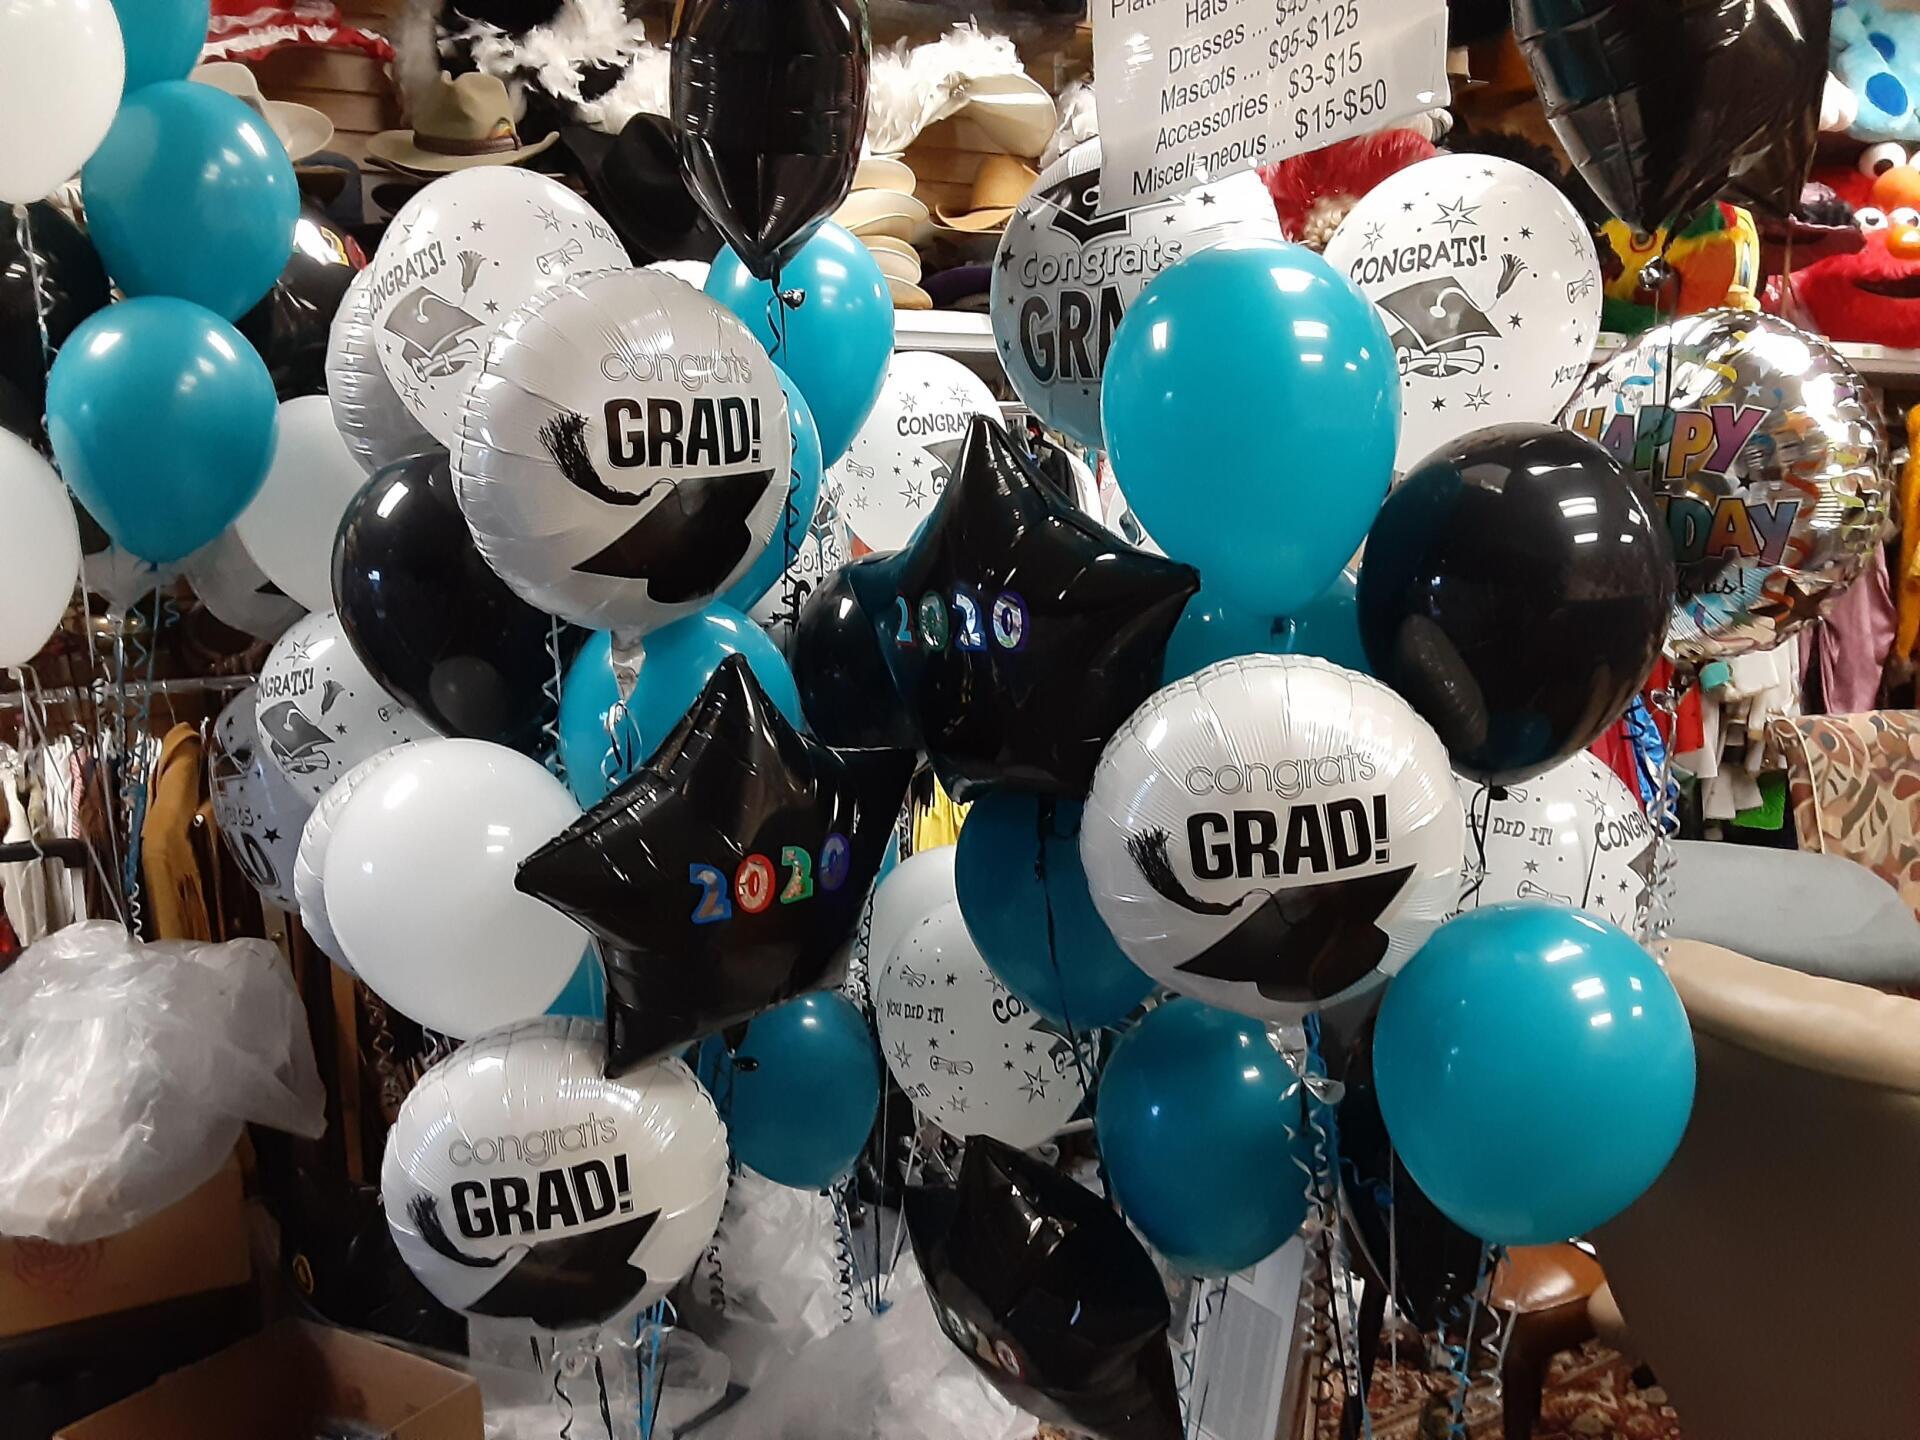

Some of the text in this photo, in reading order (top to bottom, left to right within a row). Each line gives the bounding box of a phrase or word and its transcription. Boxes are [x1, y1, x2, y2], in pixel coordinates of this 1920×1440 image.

[1161, 64, 1236, 115] Mascots
[1268, 3, 1359, 71] $95-$125
[1169, 23, 1245, 73] Dresses
[1155, 91, 1268, 154] Accessories
[1288, 41, 1363, 99] $3-$15
[1295, 79, 1387, 140] $15-$50
[1350, 234, 1488, 286] CONGRATS!
[600, 348, 753, 392] congrats
[604, 396, 762, 470] GRAD!
[1186, 745, 1377, 800] congrats
[1187, 794, 1390, 880] GRAD!
[1492, 817, 1526, 838] DID
[689, 833, 851, 925] 2020
[904, 1003, 924, 1020] DID
[448, 1112, 618, 1167] congrats
[451, 1153, 635, 1240] GRAD!
